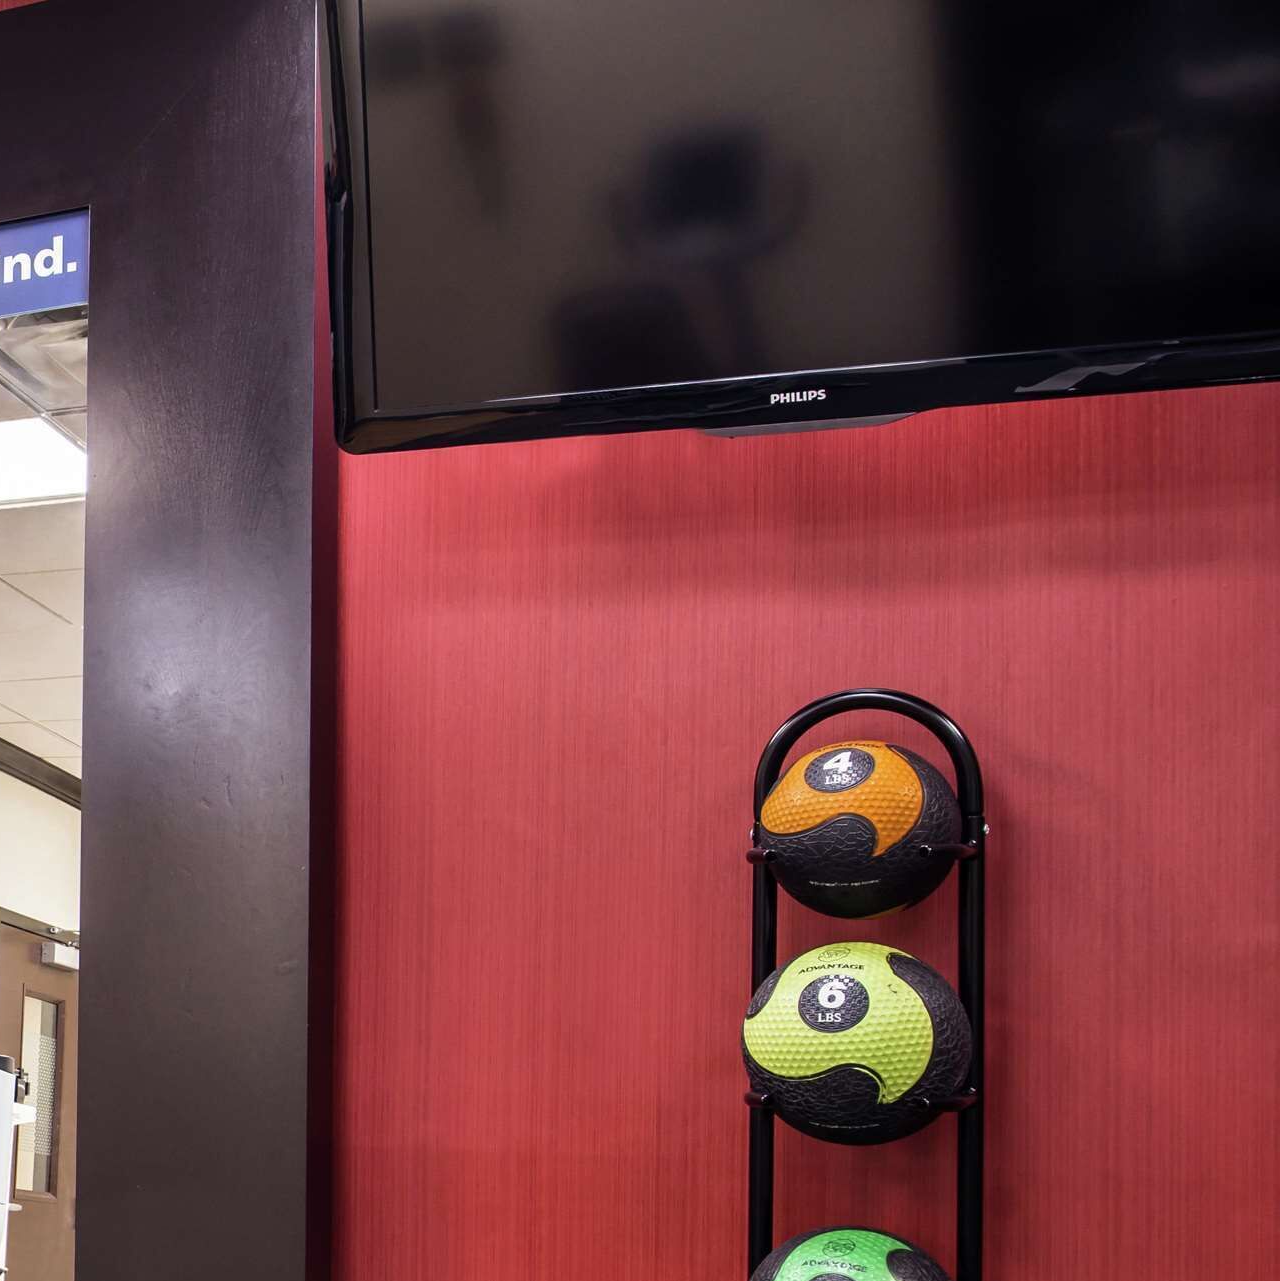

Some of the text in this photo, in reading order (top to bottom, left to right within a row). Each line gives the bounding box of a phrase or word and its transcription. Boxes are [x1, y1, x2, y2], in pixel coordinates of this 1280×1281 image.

[770, 389, 826, 405] PHILIPS
[823, 751, 853, 773] 4
[824, 774, 851, 785] LBS
[798, 963, 865, 975] ADVANTAGE
[818, 980, 847, 1009] 6
[817, 1013, 842, 1023] LBS
